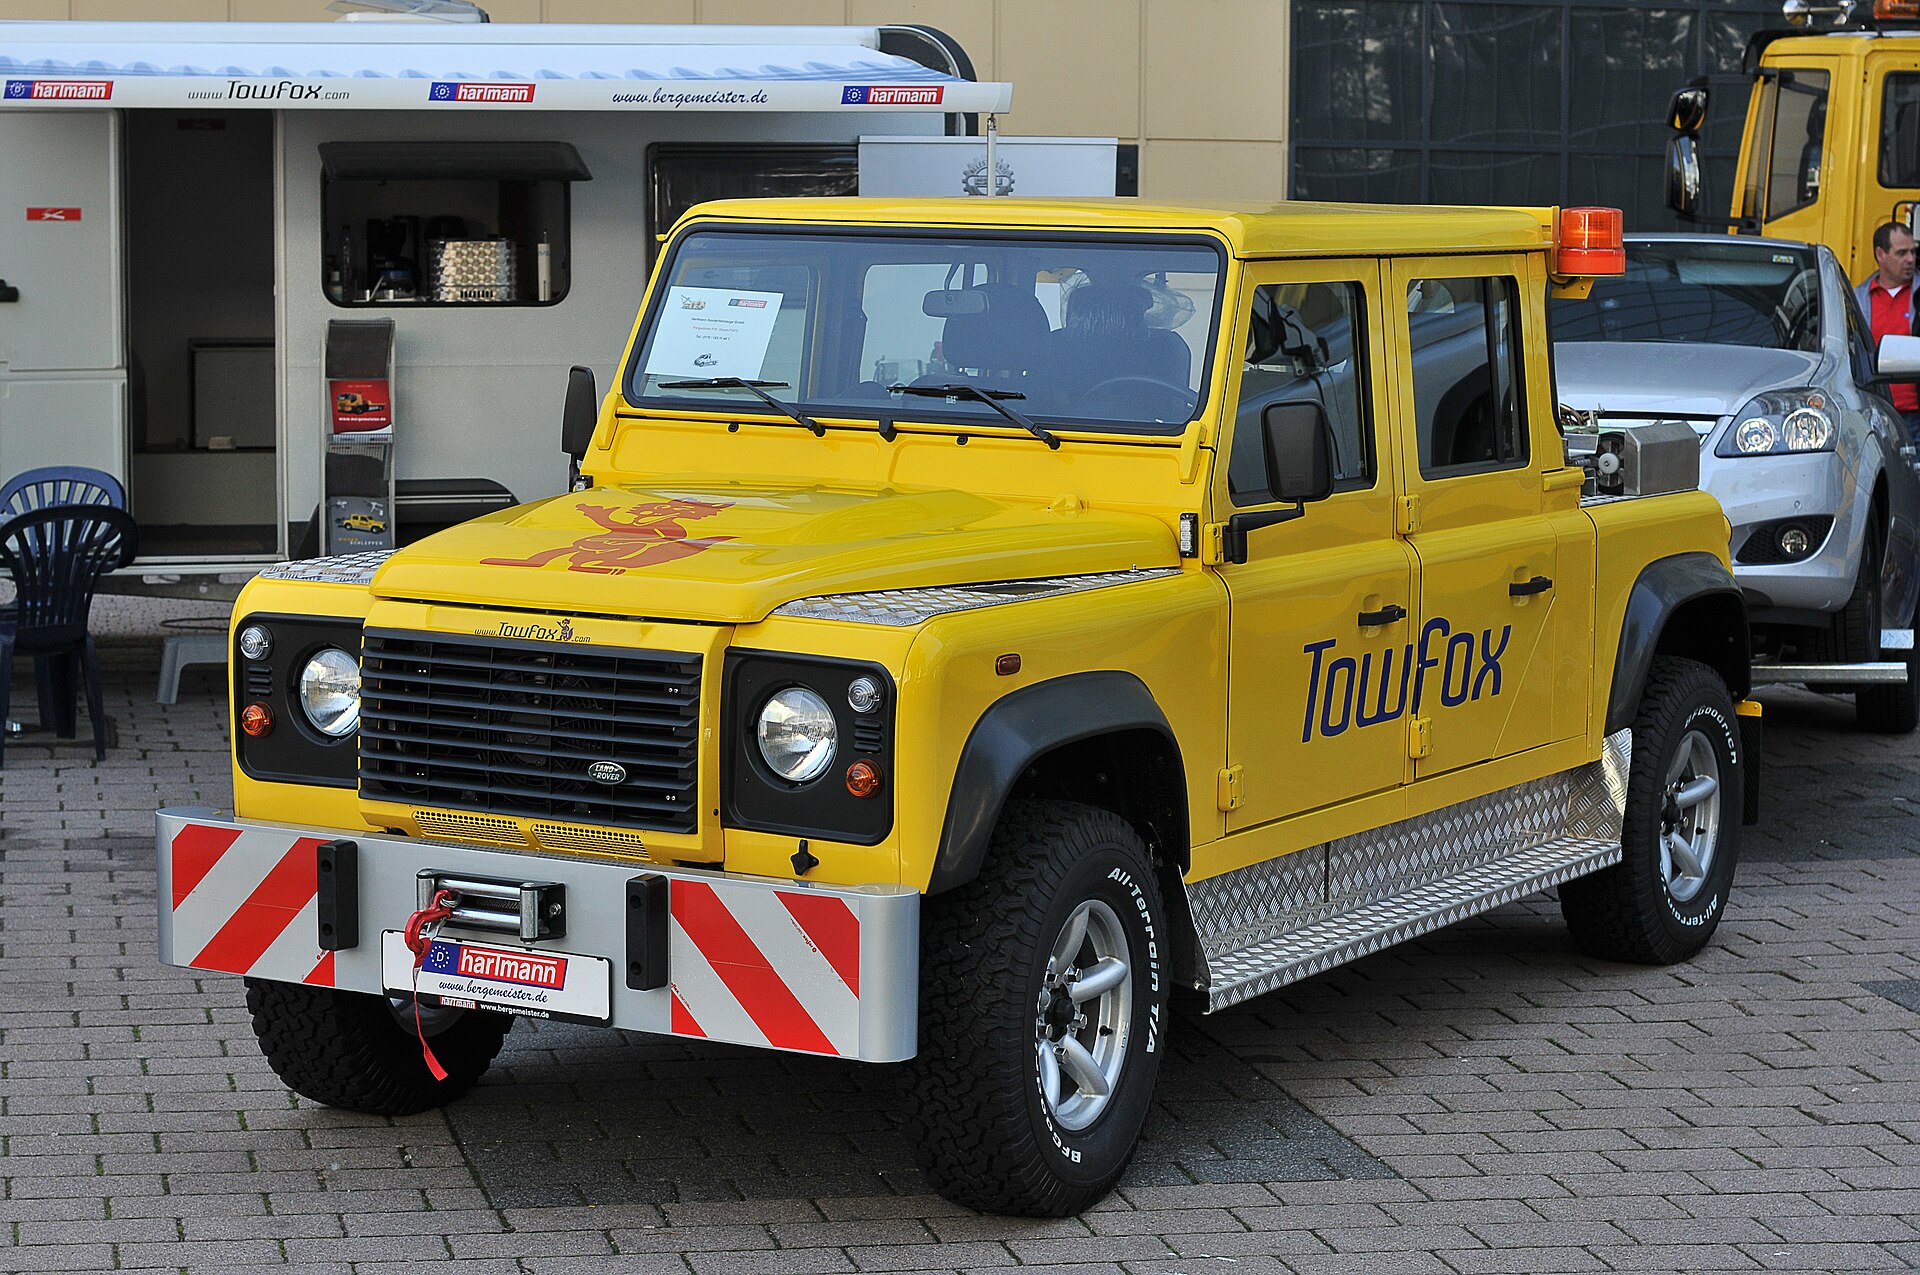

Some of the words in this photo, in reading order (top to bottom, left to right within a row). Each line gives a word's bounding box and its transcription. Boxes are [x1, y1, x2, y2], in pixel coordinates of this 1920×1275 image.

[33, 82, 107, 98] hartmann
[188, 80, 350, 100] www.TowFox.com
[457, 85, 530, 101] hartmann
[612, 86, 769, 109] www.bergemeister.de
[869, 88, 938, 103] hartmann
[1302, 617, 1511, 743] TowFox
[595, 764, 614, 773] LAND
[596, 772, 620, 781] ROVER
[459, 949, 558, 984] hartmann
[438, 980, 549, 1004] www.bergemeister.de
[440, 997, 476, 1010] hartmann
[480, 1002, 550, 1019] www.bergemeister.de
[1146, 1003, 1160, 1053] T/A
